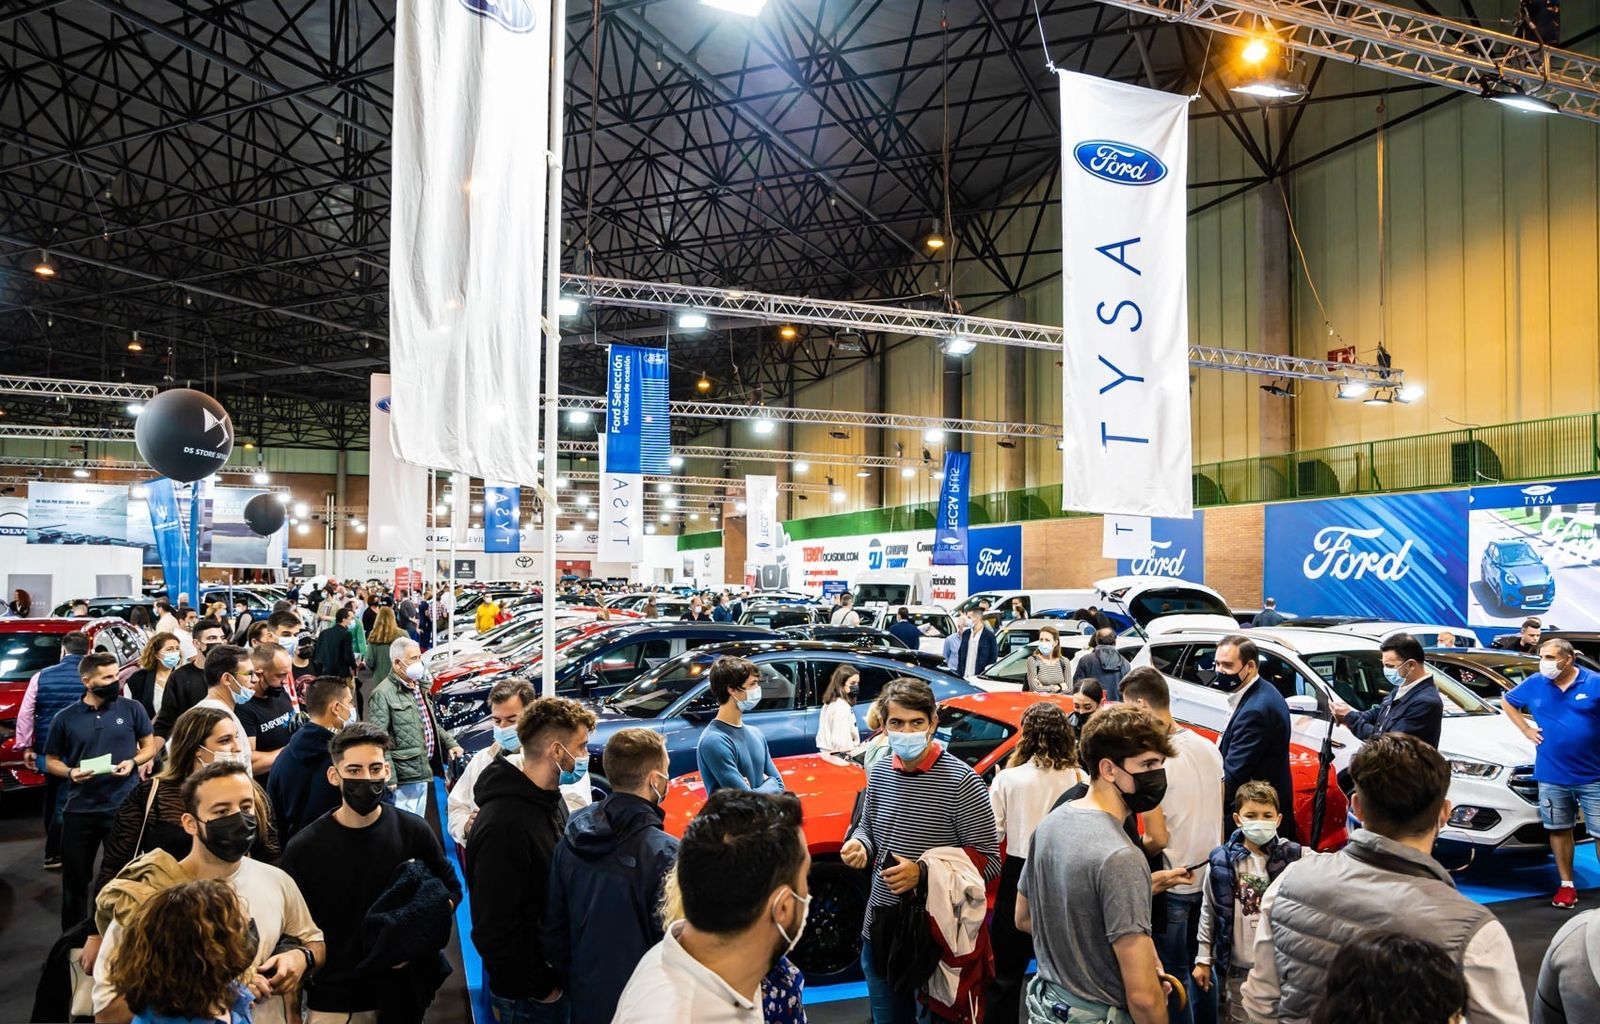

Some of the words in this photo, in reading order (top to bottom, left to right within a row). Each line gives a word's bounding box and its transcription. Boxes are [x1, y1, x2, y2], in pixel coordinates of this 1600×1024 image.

[1094, 237, 1149, 452] TYSA
[611, 354, 623, 407] Selección
[623, 382, 631, 392] de
[611, 408, 621, 434] Ford
[183, 446, 194, 454] DS
[195, 448, 216, 458] STORE
[1524, 495, 1553, 505] TYSA
[0, 527, 28, 535] OLVO
[976, 547, 1012, 577] Ford
[1303, 526, 1414, 581] Ford
